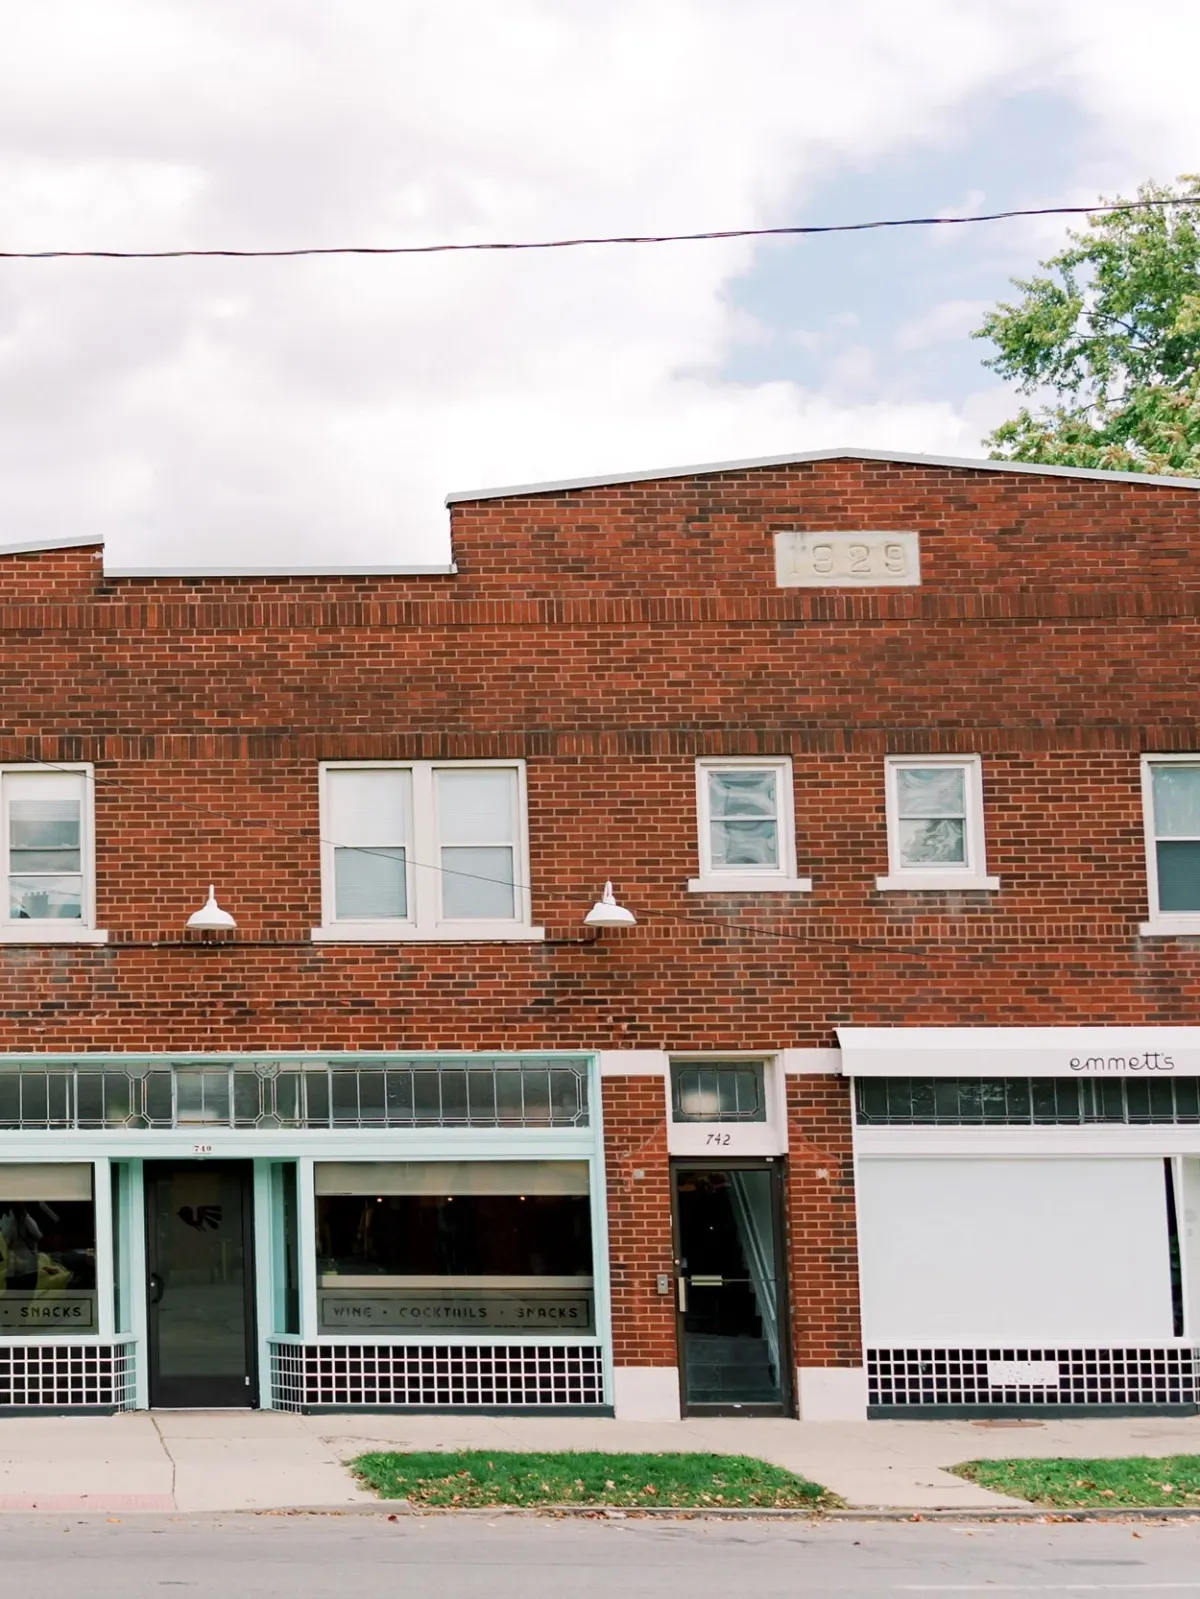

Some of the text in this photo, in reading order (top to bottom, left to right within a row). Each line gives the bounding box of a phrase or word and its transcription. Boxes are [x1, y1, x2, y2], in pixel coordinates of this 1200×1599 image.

[1070, 1052, 1175, 1070] emmett's
[706, 1133, 731, 1146] 742
[20, 1307, 83, 1318] SNACKS
[333, 1306, 579, 1319] WINE COCKTAILS SNACKS
